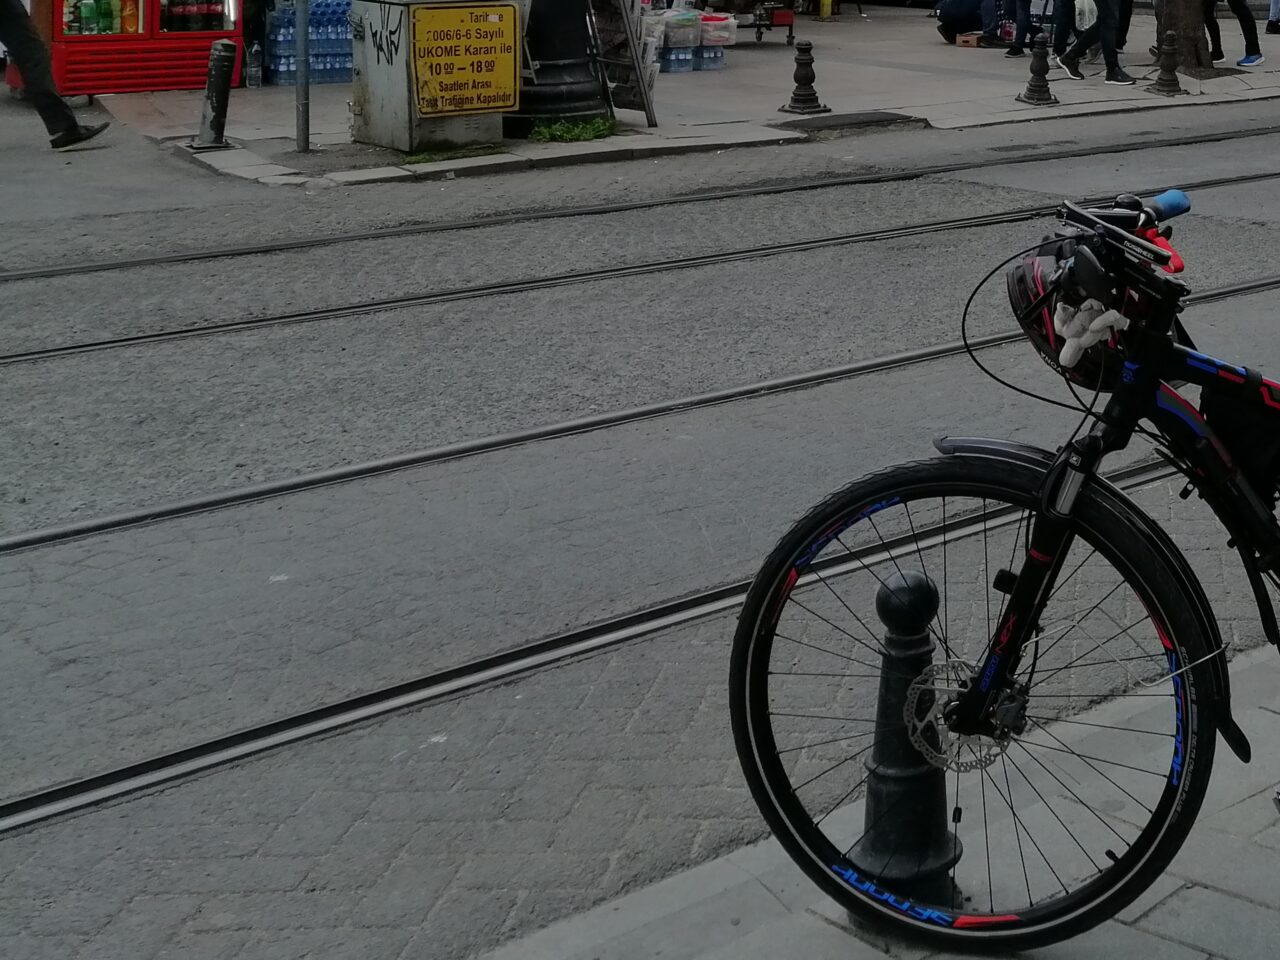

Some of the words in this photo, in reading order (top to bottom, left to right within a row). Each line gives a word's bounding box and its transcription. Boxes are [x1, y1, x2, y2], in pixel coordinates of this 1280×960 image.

[475, 27, 504, 41] Sayılı
[418, 45, 461, 58] UKOME
[464, 44, 497, 56] Kararı
[500, 43, 513, 54] ile
[438, 80, 469, 92] Saatleri
[471, 79, 492, 90] Arası
[476, 92, 512, 106] Kapalıdır
